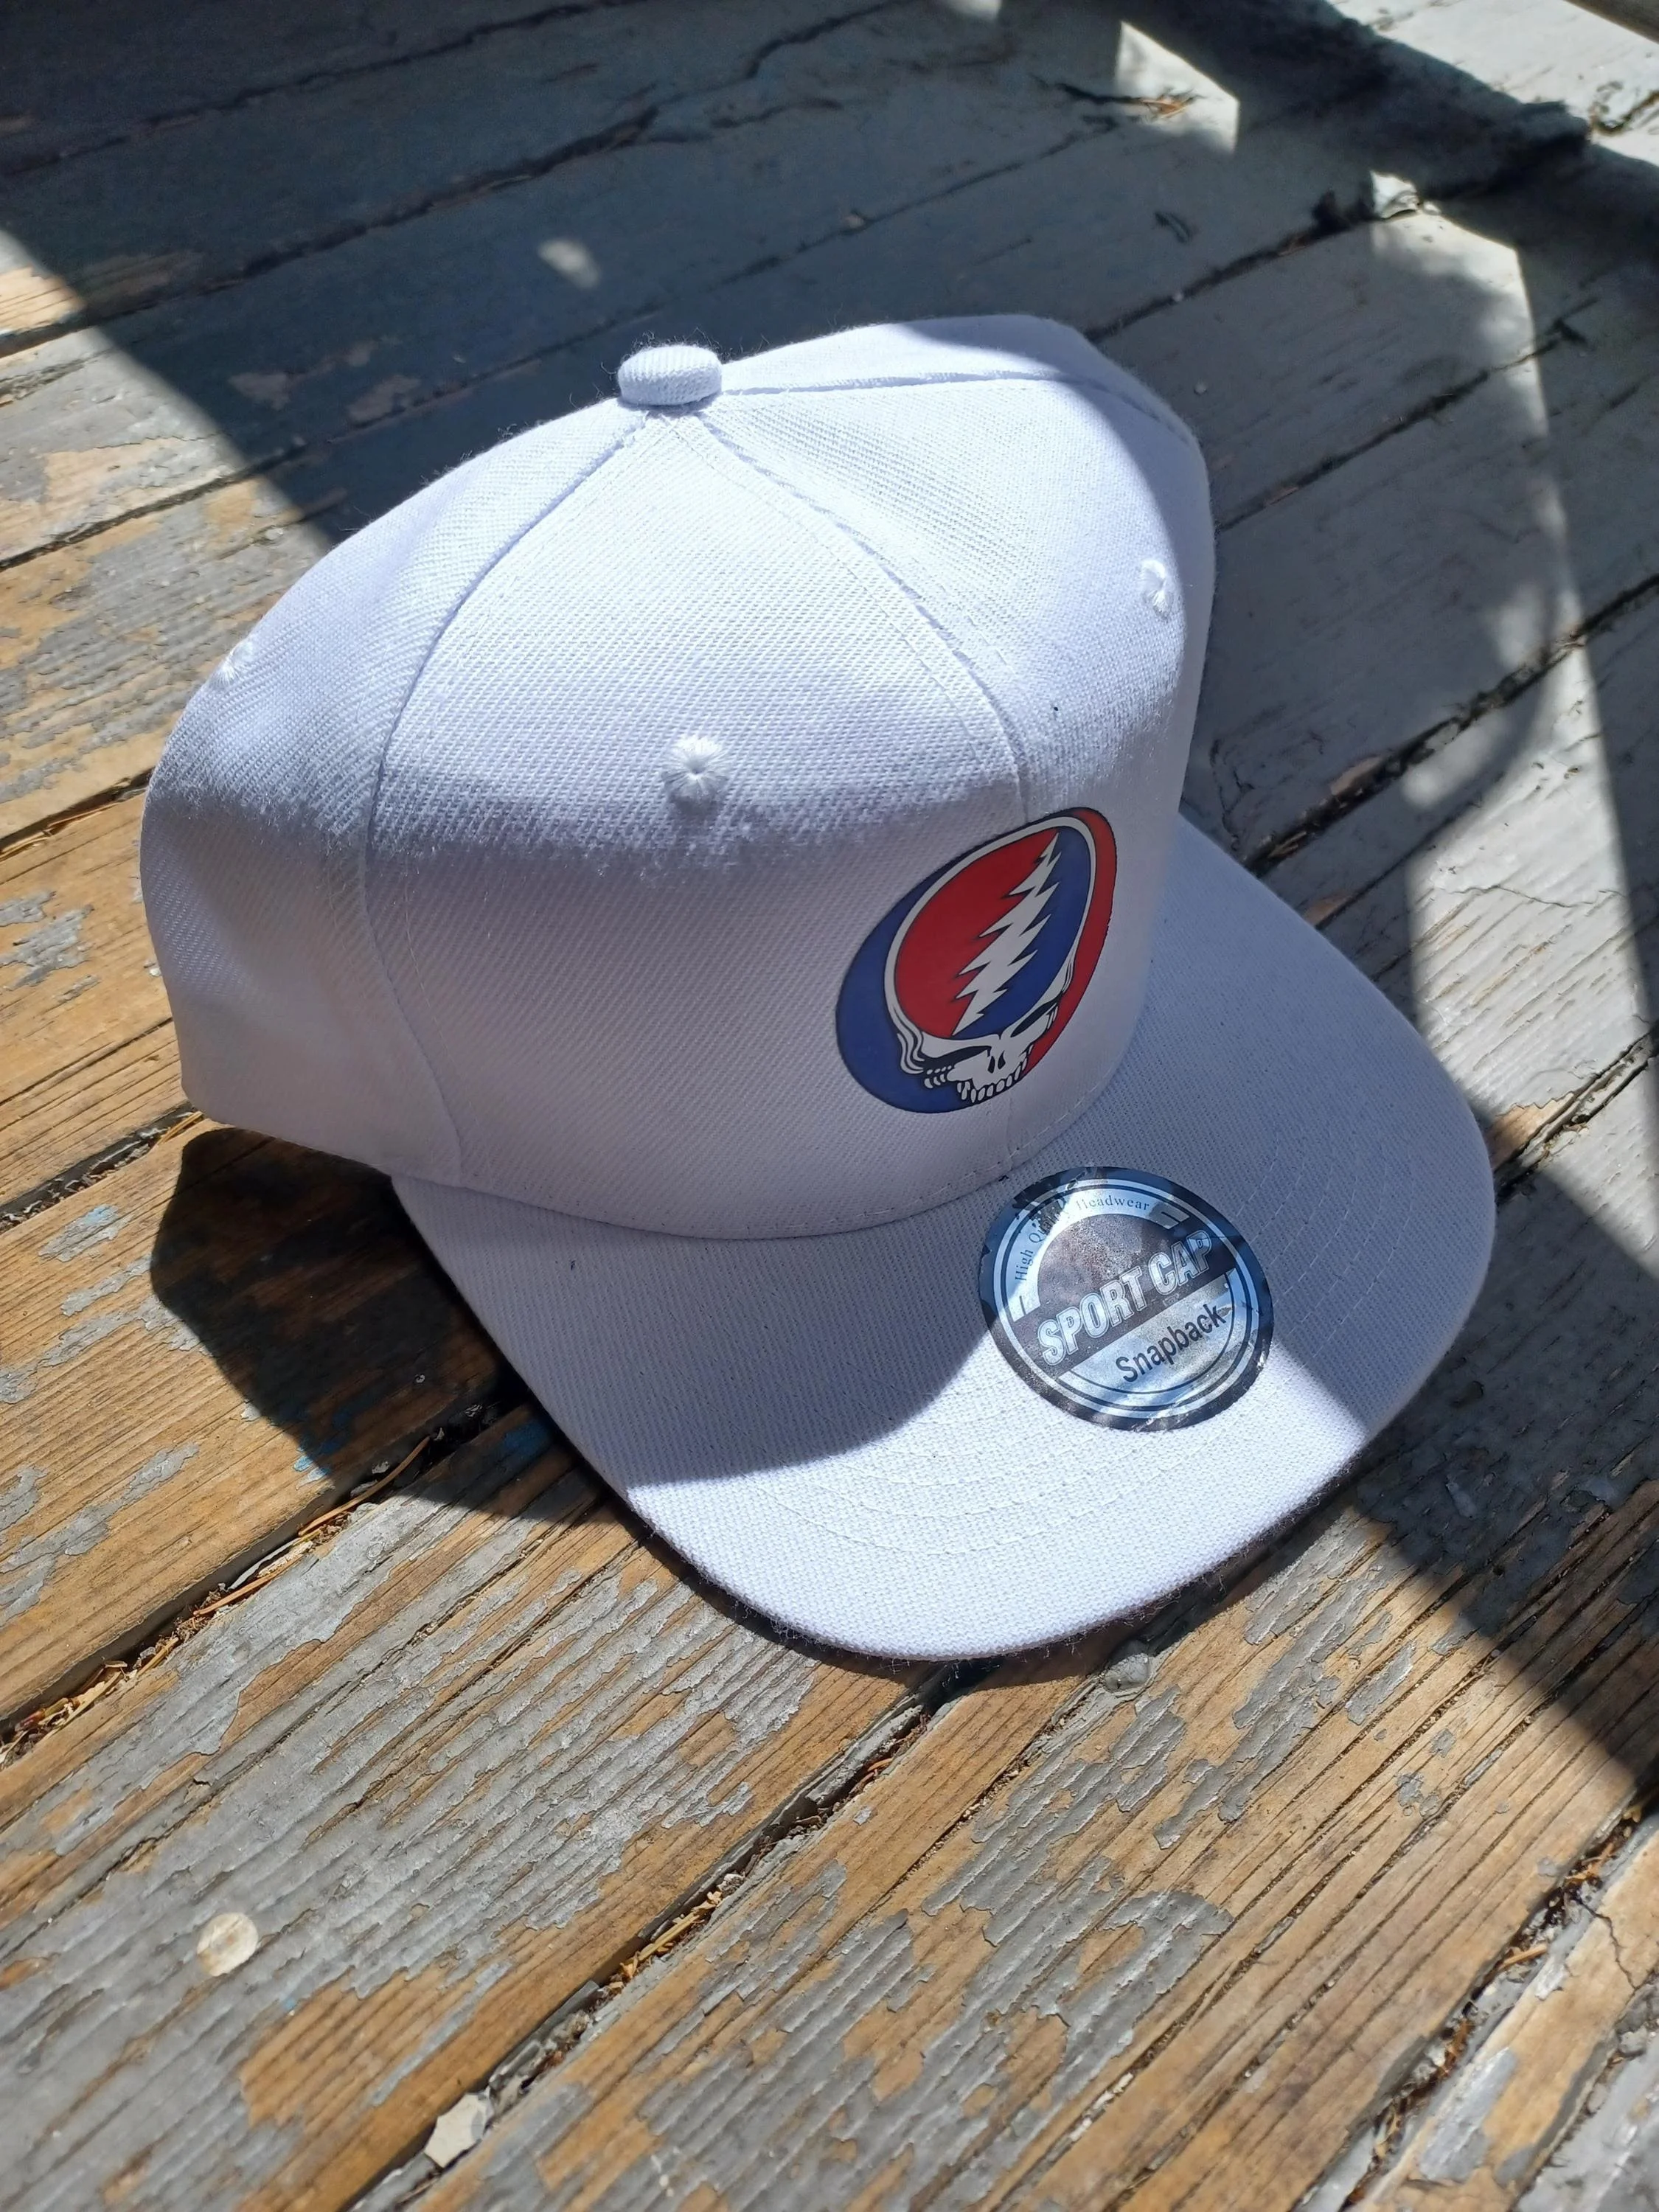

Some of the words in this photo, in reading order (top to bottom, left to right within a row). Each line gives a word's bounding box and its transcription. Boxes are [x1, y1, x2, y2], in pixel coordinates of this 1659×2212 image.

[1015, 1249, 1034, 1281] High
[1076, 1195, 1150, 1211] Headwear
[1038, 1266, 1147, 1366] SPORT
[1148, 1231, 1213, 1295] CAP
[1116, 1304, 1226, 1382] Snapback
